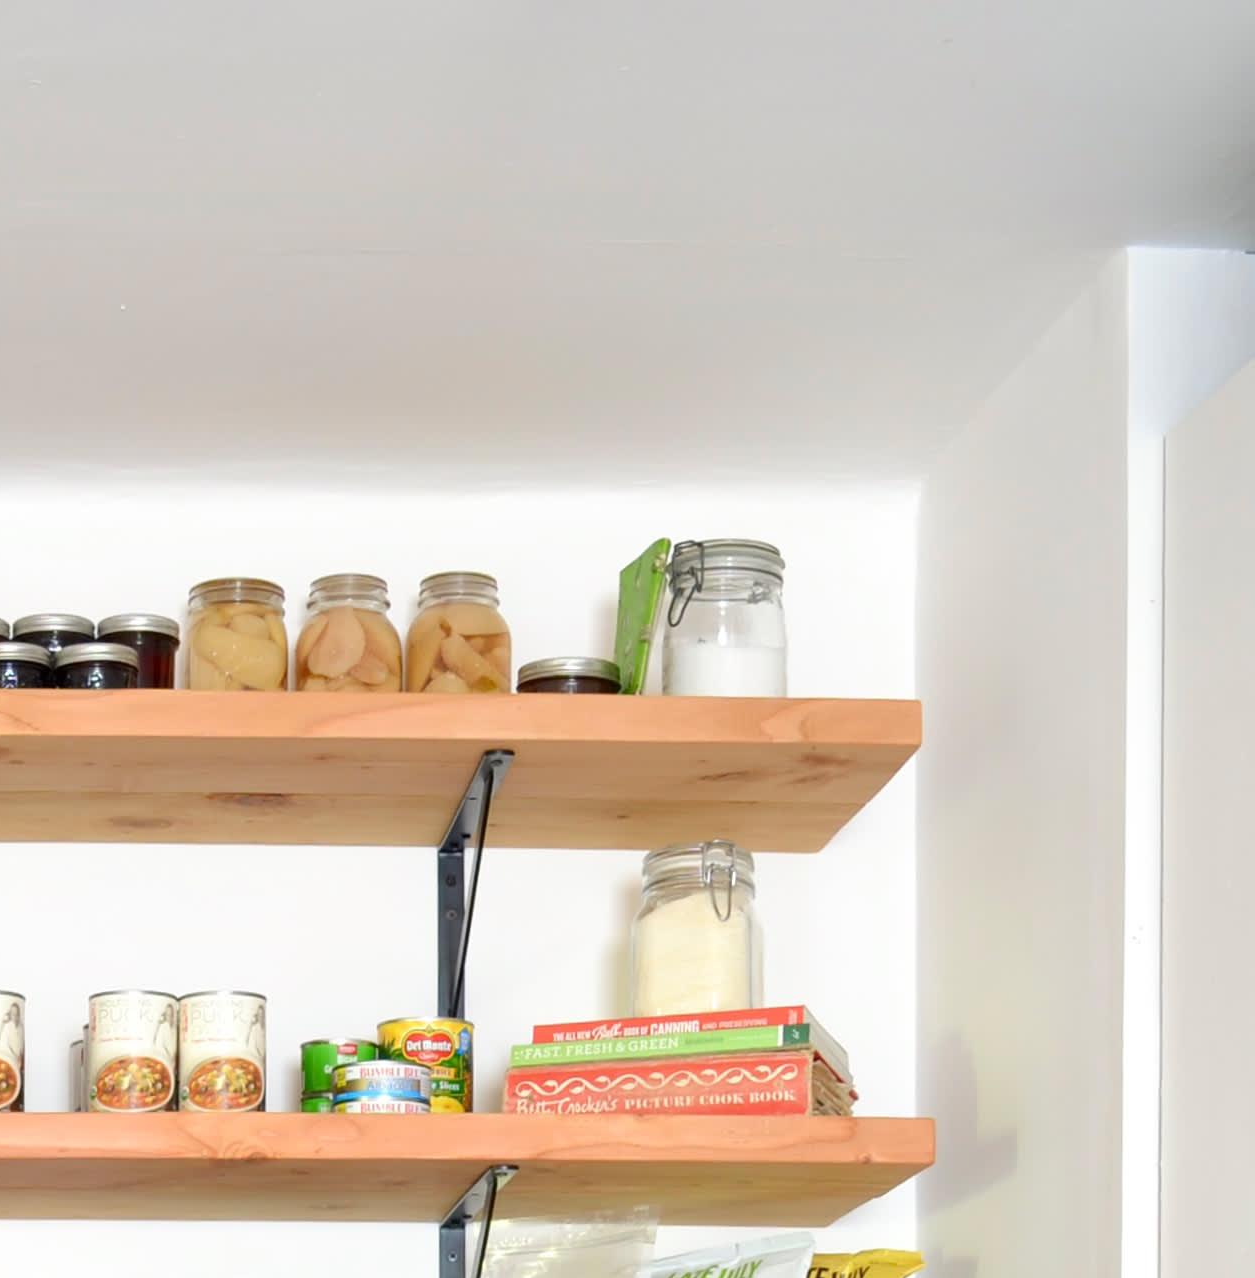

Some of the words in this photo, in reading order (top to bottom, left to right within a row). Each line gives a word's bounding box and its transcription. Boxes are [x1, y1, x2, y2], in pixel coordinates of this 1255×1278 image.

[650, 1020, 700, 1036] CANNING
[406, 1040, 422, 1051] Del
[423, 1039, 452, 1052] Monte
[566, 1043, 614, 1057] FRESH
[615, 1041, 626, 1052] &
[628, 1037, 679, 1052] GREEN
[625, 1096, 694, 1110] PICTURE
[699, 1092, 745, 1106] COOK
[749, 1089, 796, 1102] BOOK
